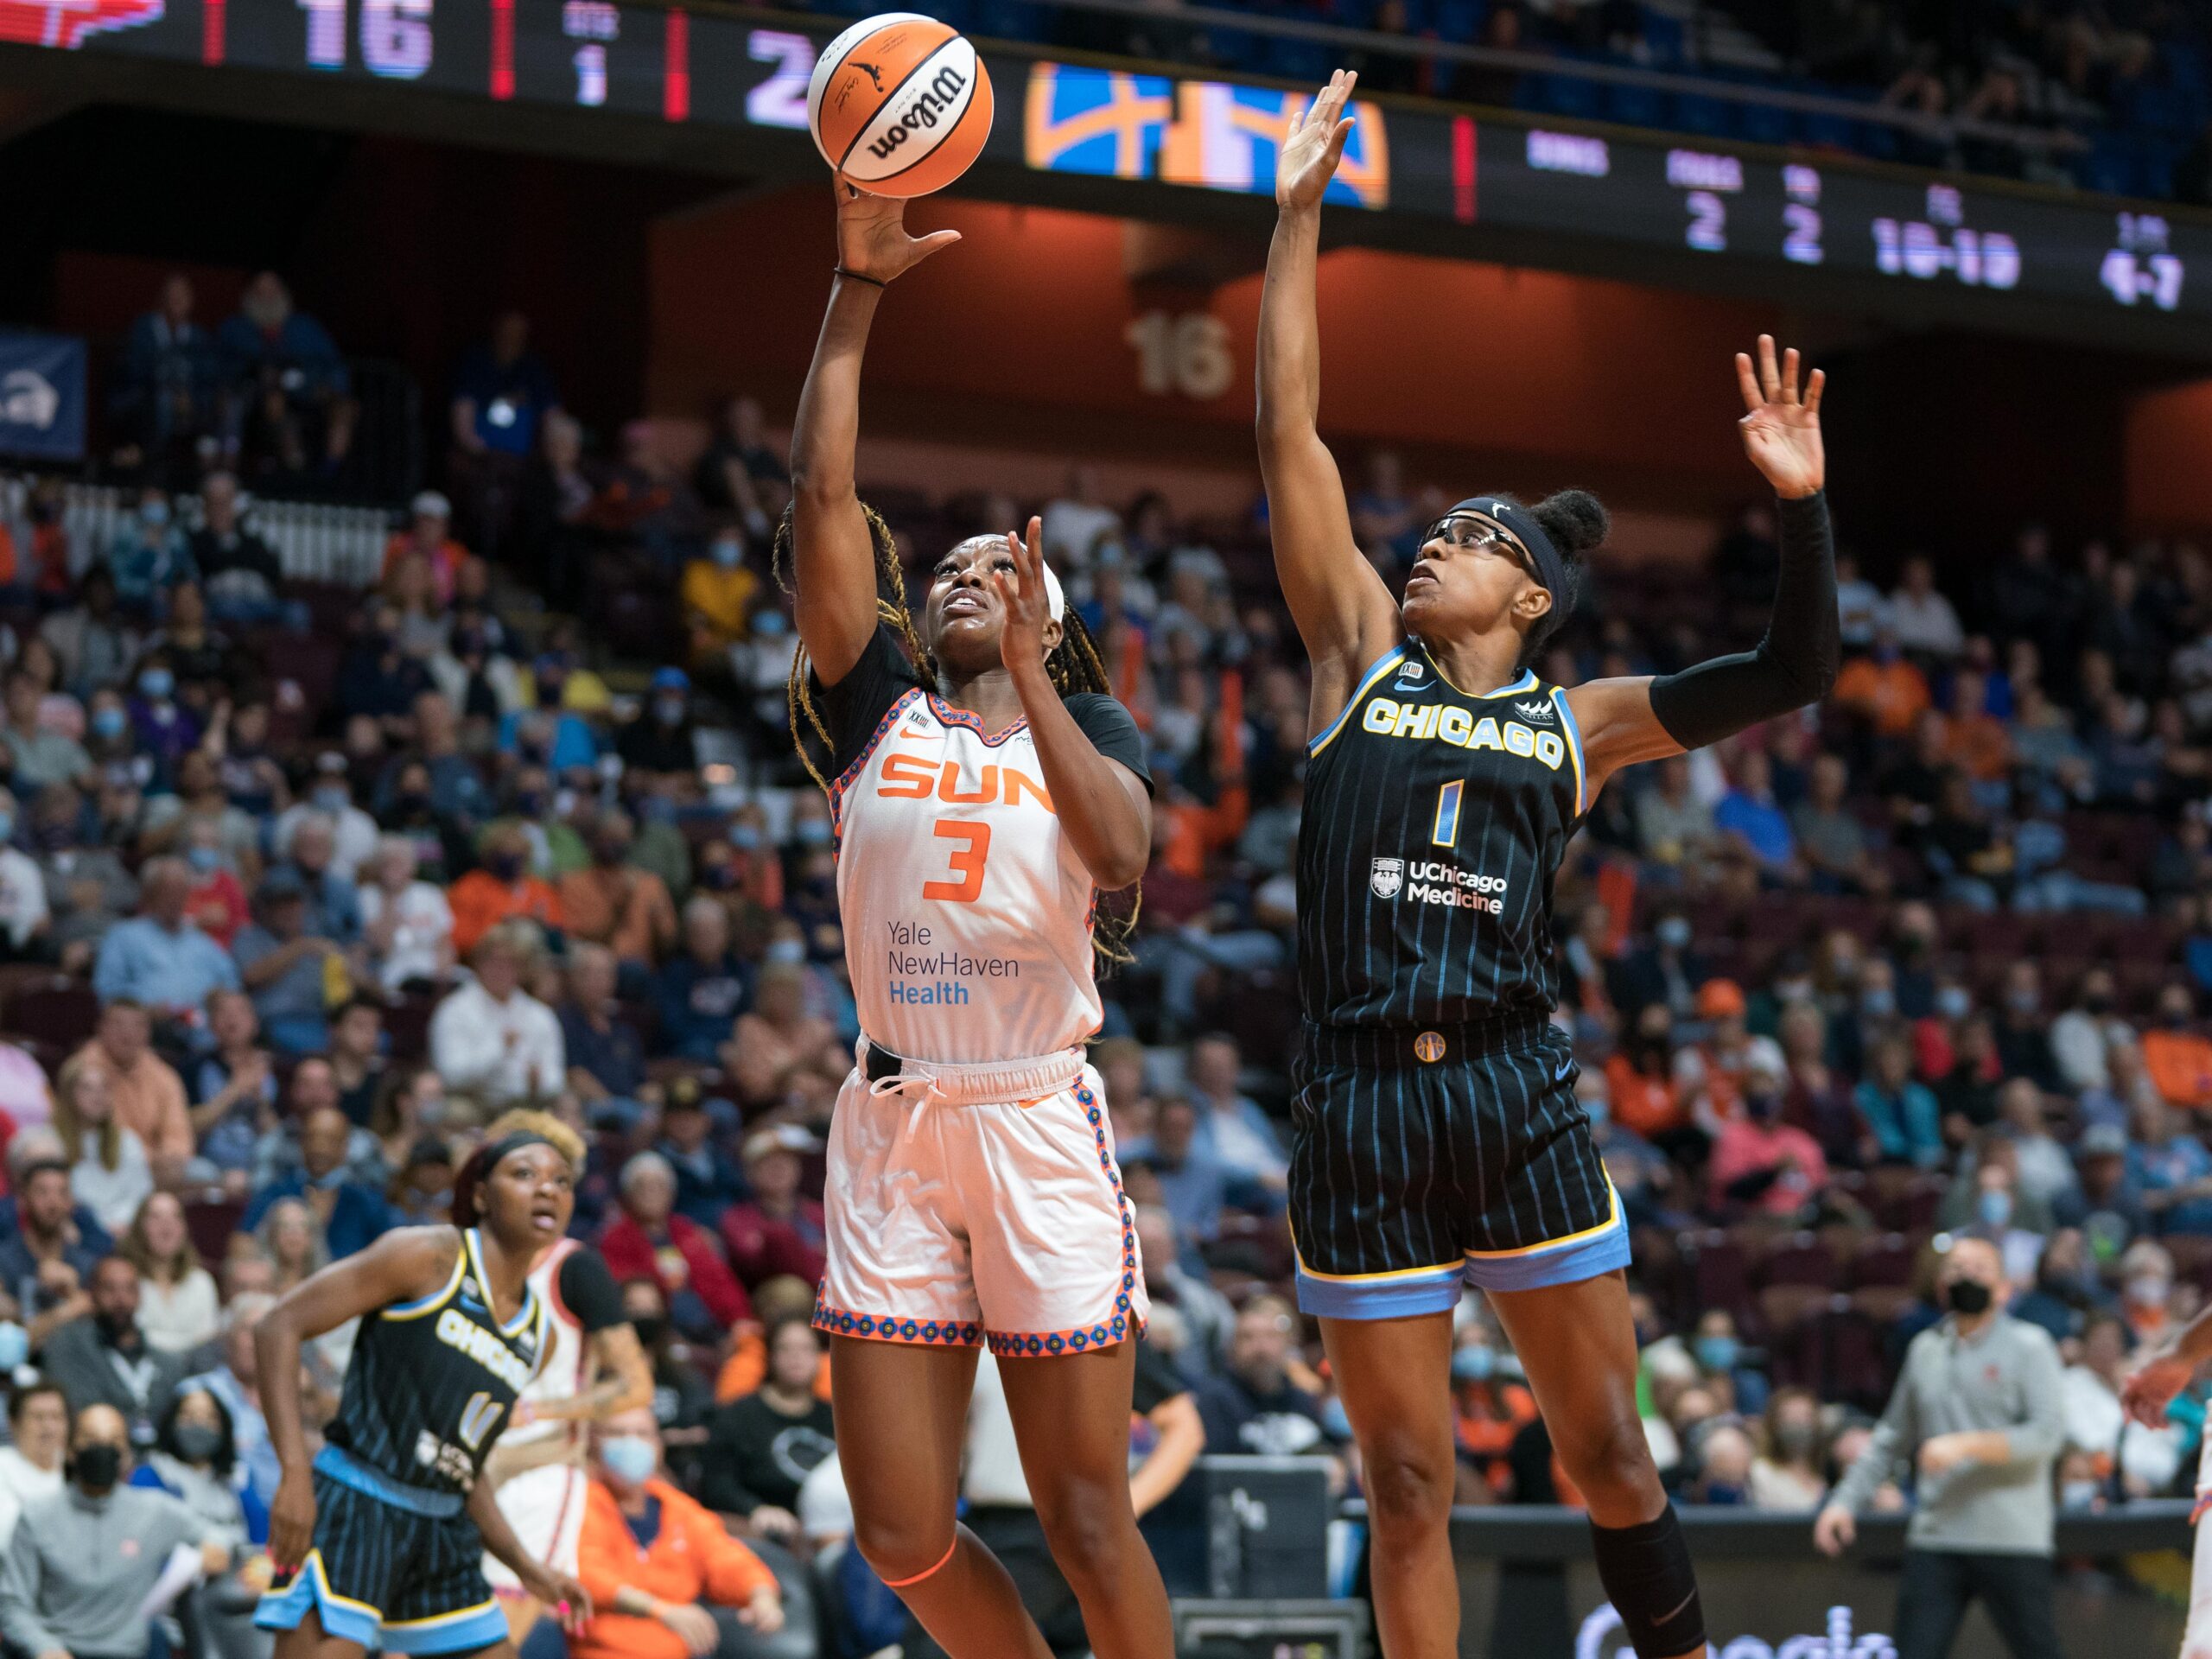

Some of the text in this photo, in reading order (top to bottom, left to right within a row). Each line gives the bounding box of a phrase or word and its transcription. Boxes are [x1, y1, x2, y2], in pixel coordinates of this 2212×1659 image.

[868, 66, 966, 159] Wilson
[1686, 190, 1727, 251] 2
[1783, 203, 1823, 264] 2
[1127, 313, 1234, 398] 16
[1362, 697, 1565, 771] CHICAGO
[877, 753, 1057, 815] SUN
[1432, 779, 1465, 848] 1
[923, 819, 991, 902] 3
[1409, 861, 1508, 893] UChicago
[1408, 882, 1503, 915] Medicine
[887, 920, 931, 945] Yale
[888, 951, 1019, 977] NewHaven
[889, 981, 969, 1005] Health
